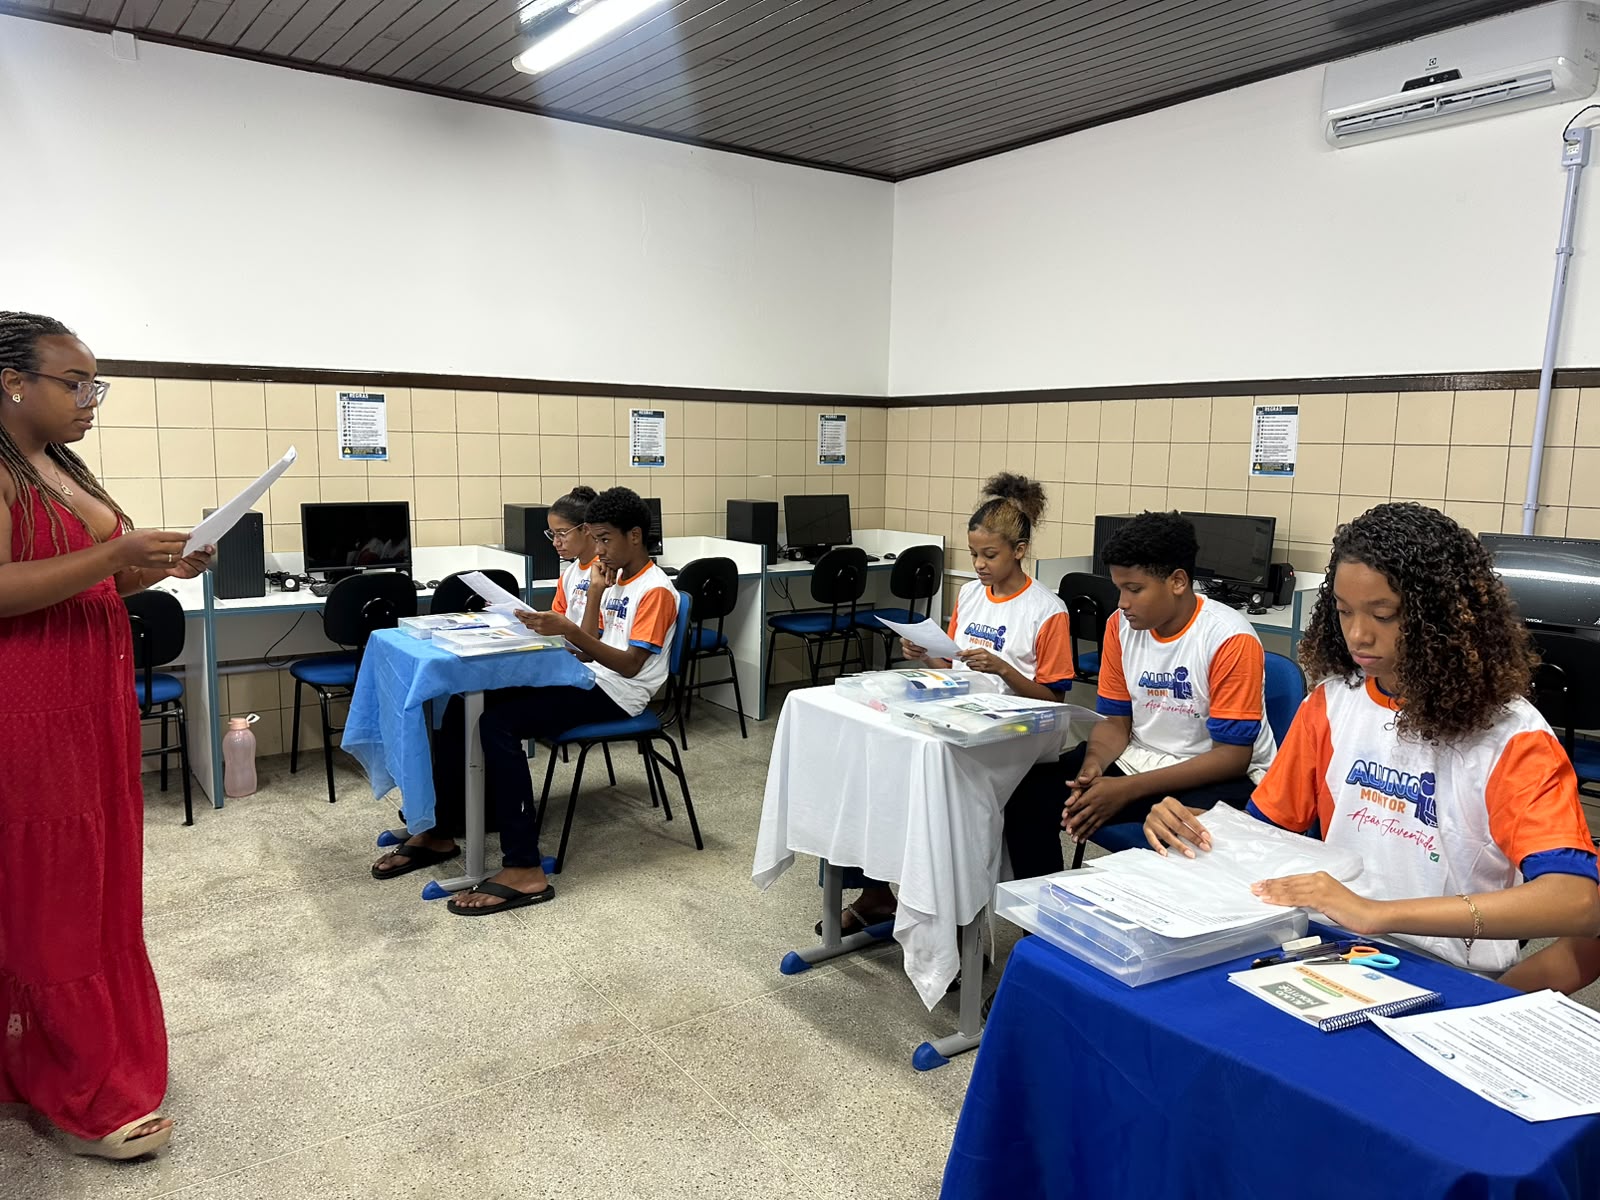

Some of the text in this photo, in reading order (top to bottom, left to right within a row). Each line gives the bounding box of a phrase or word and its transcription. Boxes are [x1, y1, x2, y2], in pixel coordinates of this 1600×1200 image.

[1147, 689, 1169, 698] MONI
[1345, 759, 1421, 804] ALUNO
[1360, 788, 1406, 813] MONTOR
